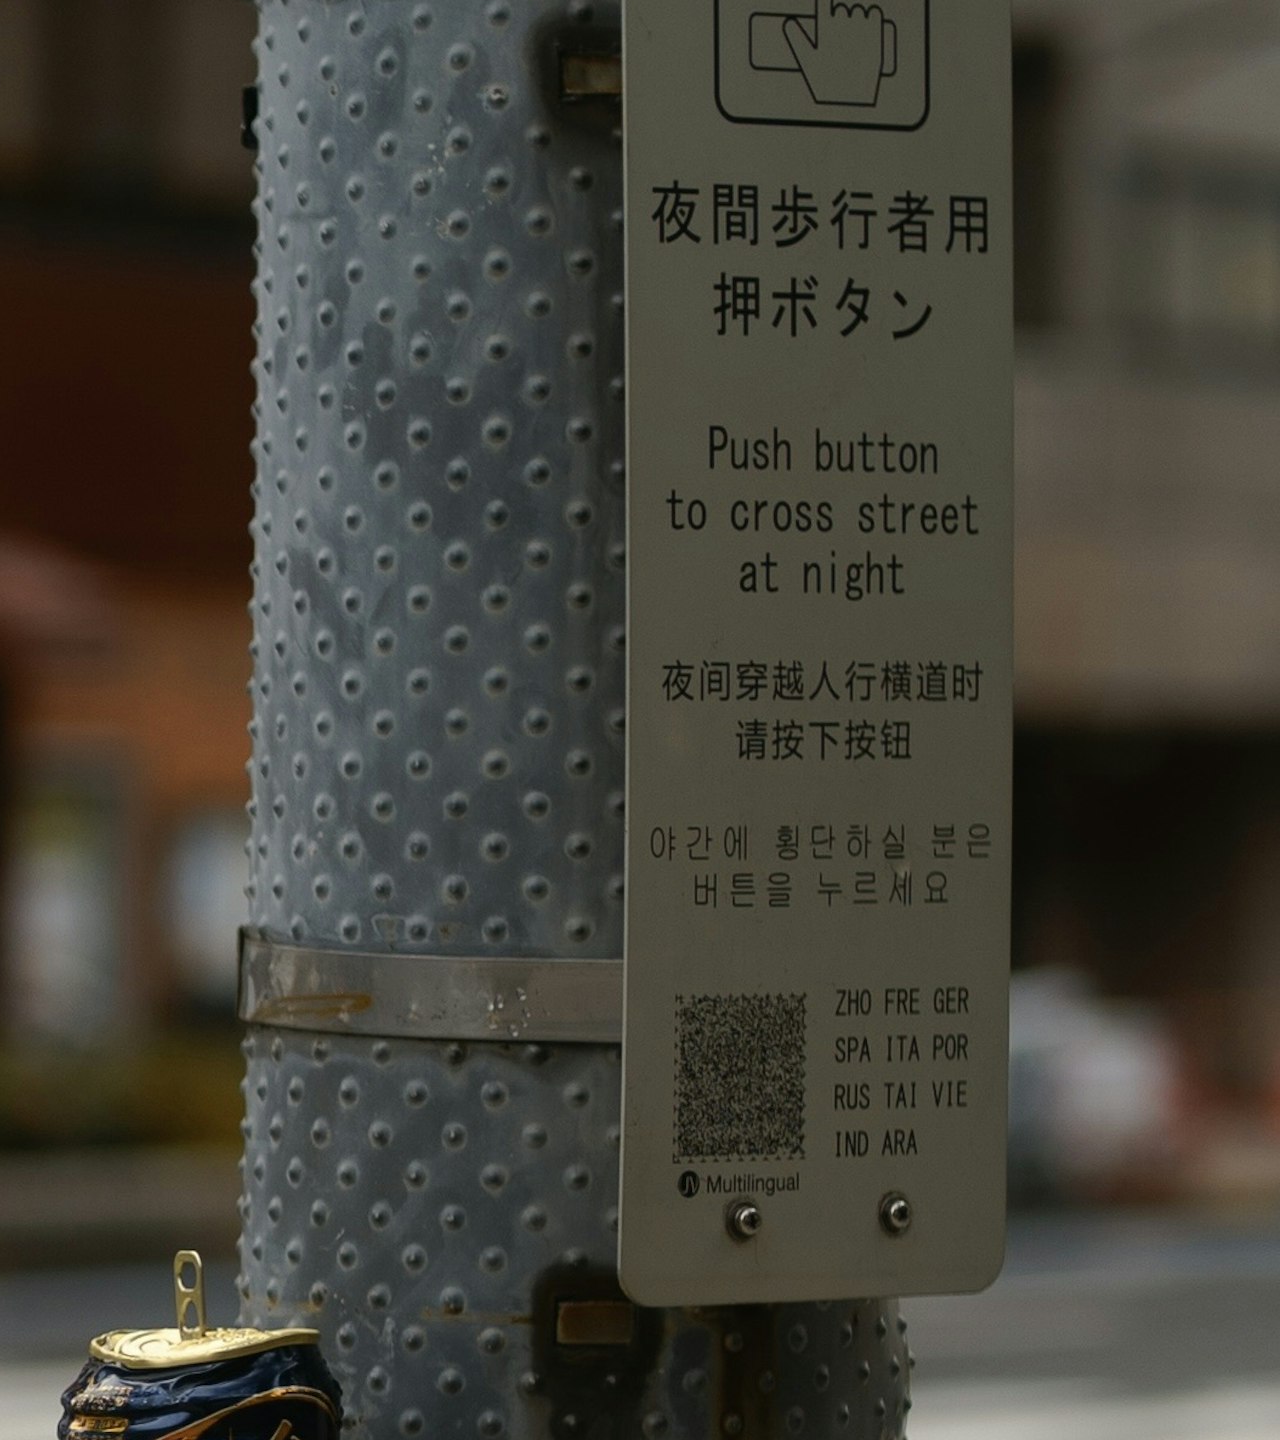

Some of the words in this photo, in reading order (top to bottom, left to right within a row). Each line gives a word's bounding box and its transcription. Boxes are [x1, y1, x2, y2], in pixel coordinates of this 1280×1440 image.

[652, 180, 987, 253] 夜間歩行者用
[714, 272, 931, 339] 押ボタン
[710, 426, 790, 470] Push
[816, 429, 937, 473] button
[666, 490, 706, 530] to
[731, 501, 832, 532] cross
[859, 494, 978, 534] street
[740, 553, 778, 592] at
[804, 551, 904, 601] night
[663, 660, 983, 701] 夜间穿越人行横道时
[736, 719, 911, 760] 请按下按钮
[651, 826, 747, 860] 야간에
[776, 824, 904, 860] 횡단하실
[932, 824, 990, 858] 분은
[695, 872, 791, 907] 버튼을
[818, 872, 947, 906] 누르세요
[836, 990, 871, 1016] ZHO
[885, 989, 919, 1014] FRE
[934, 988, 968, 1013] GER
[835, 1037, 870, 1062] SPA
[888, 1036, 919, 1061] ITA
[933, 1034, 968, 1060] POR
[835, 1084, 869, 1109] RUS
[885, 1082, 915, 1108] TAI
[933, 1081, 966, 1107] VIE
[836, 1131, 868, 1157] IND
[882, 1130, 917, 1155] ARA
[707, 1173, 799, 1197] Multilingual
